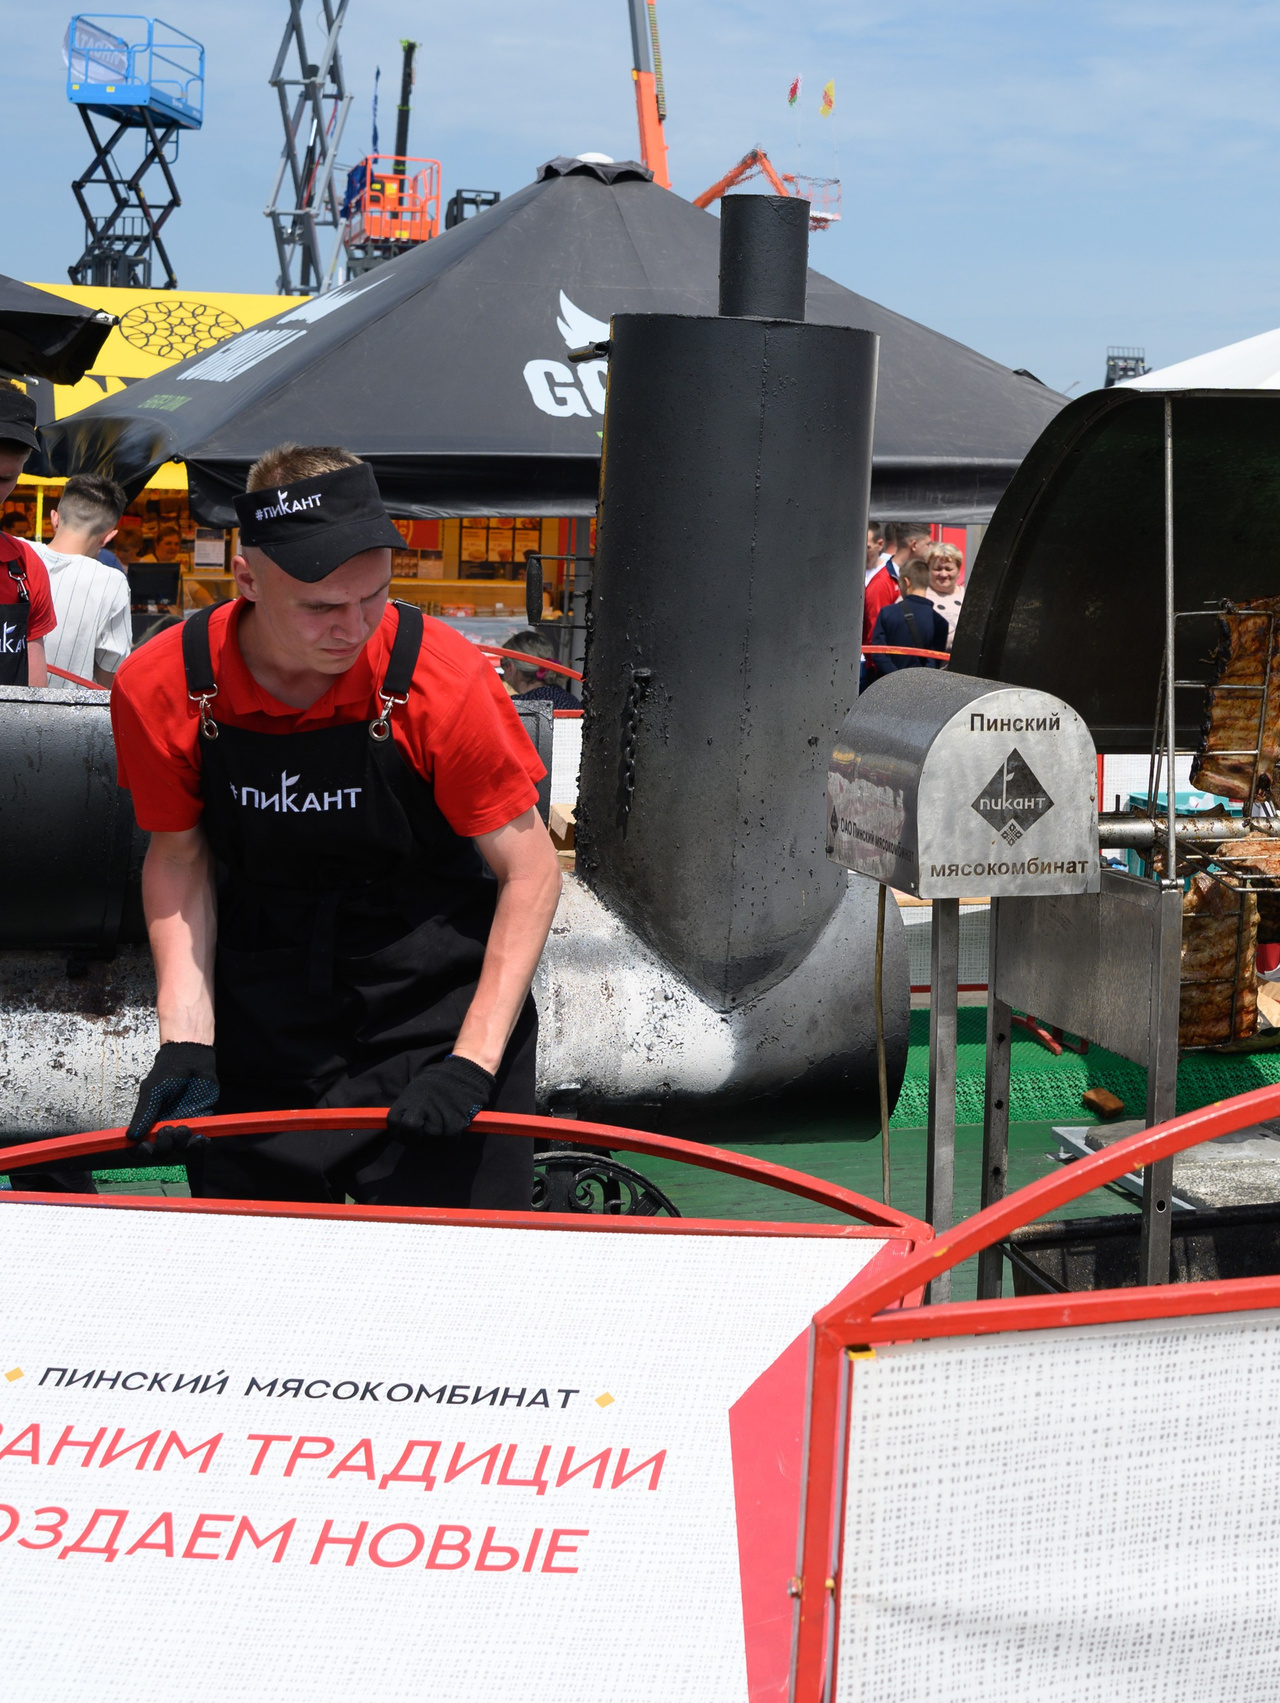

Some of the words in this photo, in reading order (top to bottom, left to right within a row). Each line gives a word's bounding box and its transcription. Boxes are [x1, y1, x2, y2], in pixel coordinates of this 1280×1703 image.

[970, 712, 1061, 732] Пинский
[930, 857, 1089, 878] мясокомбинат
[38, 1367, 230, 1395] ПИНСКИЙ
[244, 1376, 580, 1409] МЯСОКОМБИНАТ
[0, 1423, 224, 1474] АНИМ
[247, 1433, 667, 1496] ТРАДИЦИИ
[309, 1518, 590, 1574] НОВЫЕ
